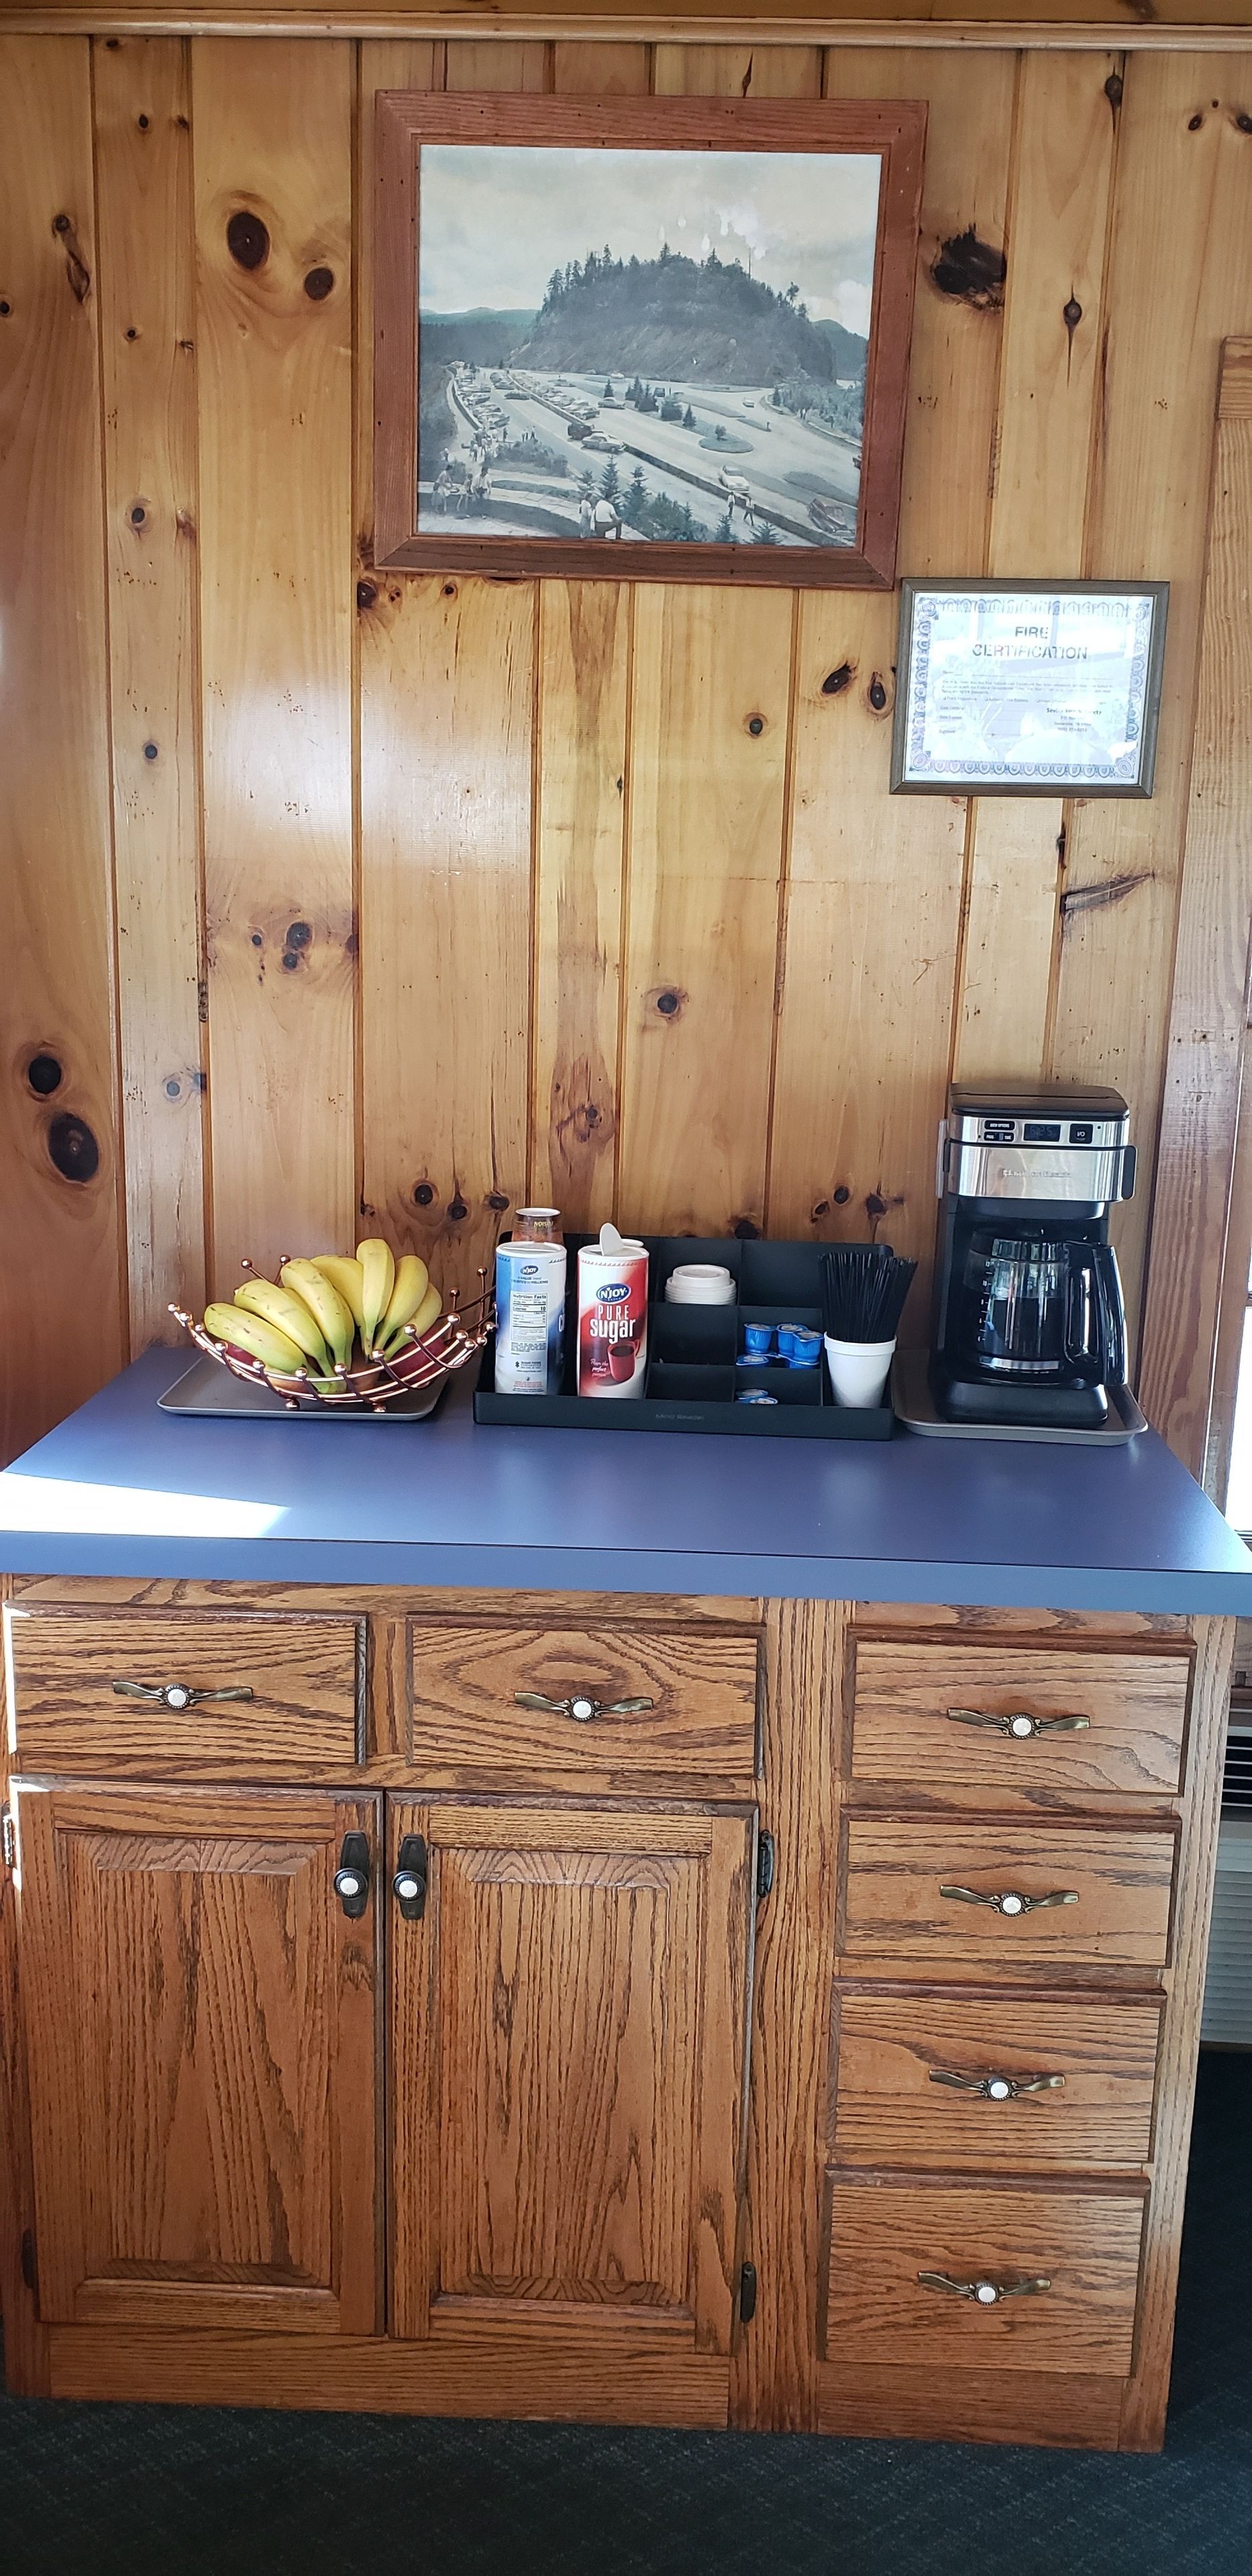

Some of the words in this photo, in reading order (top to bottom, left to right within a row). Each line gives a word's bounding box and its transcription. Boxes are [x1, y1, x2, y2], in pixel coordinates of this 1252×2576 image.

[1015, 627, 1048, 639] FIRE
[973, 644, 1088, 659] CERTIFICATION
[601, 1287, 625, 1299] N'JOY
[598, 1305, 629, 1320] PURE
[590, 1318, 636, 1344] sugar
